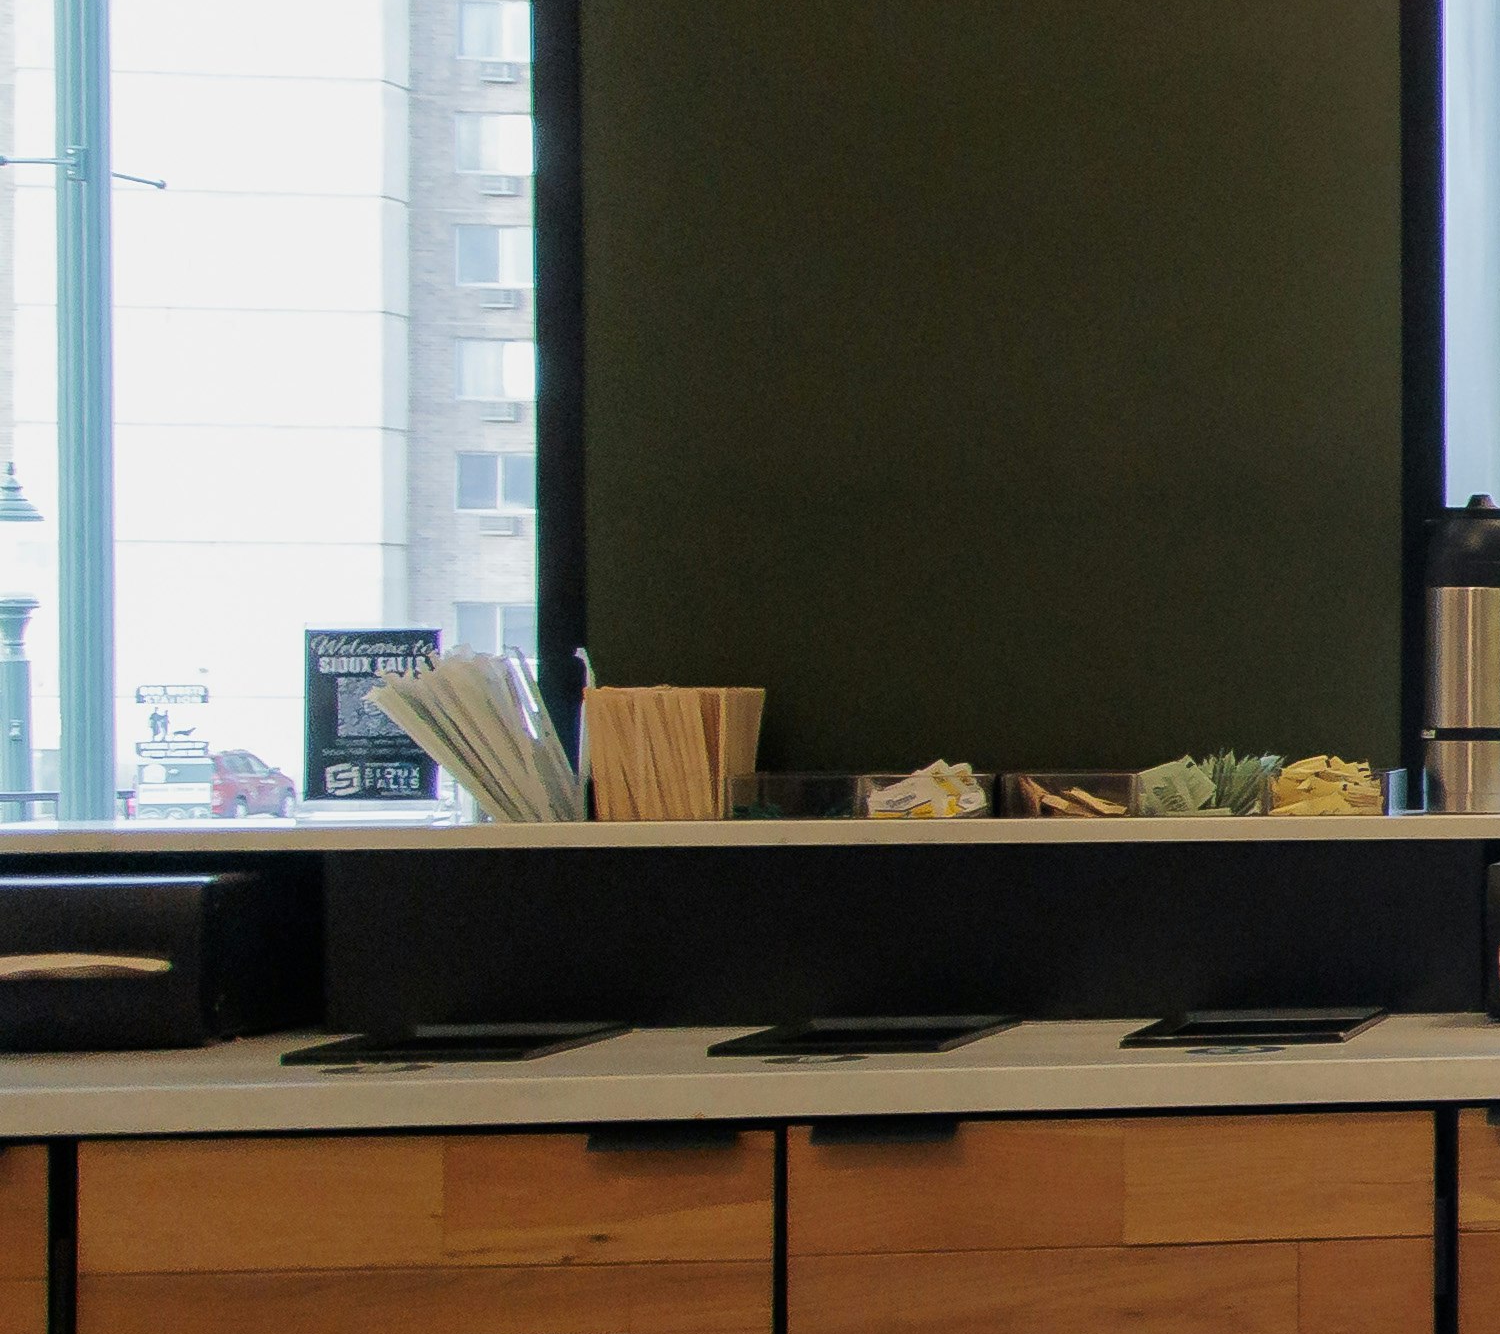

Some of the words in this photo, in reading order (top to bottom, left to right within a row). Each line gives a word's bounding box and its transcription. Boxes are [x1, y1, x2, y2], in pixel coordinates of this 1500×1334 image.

[311, 634, 408, 655] Welcome
[319, 656, 372, 674] SIOUX
[364, 767, 420, 779] SIOUX
[364, 778, 420, 789] FALLS
